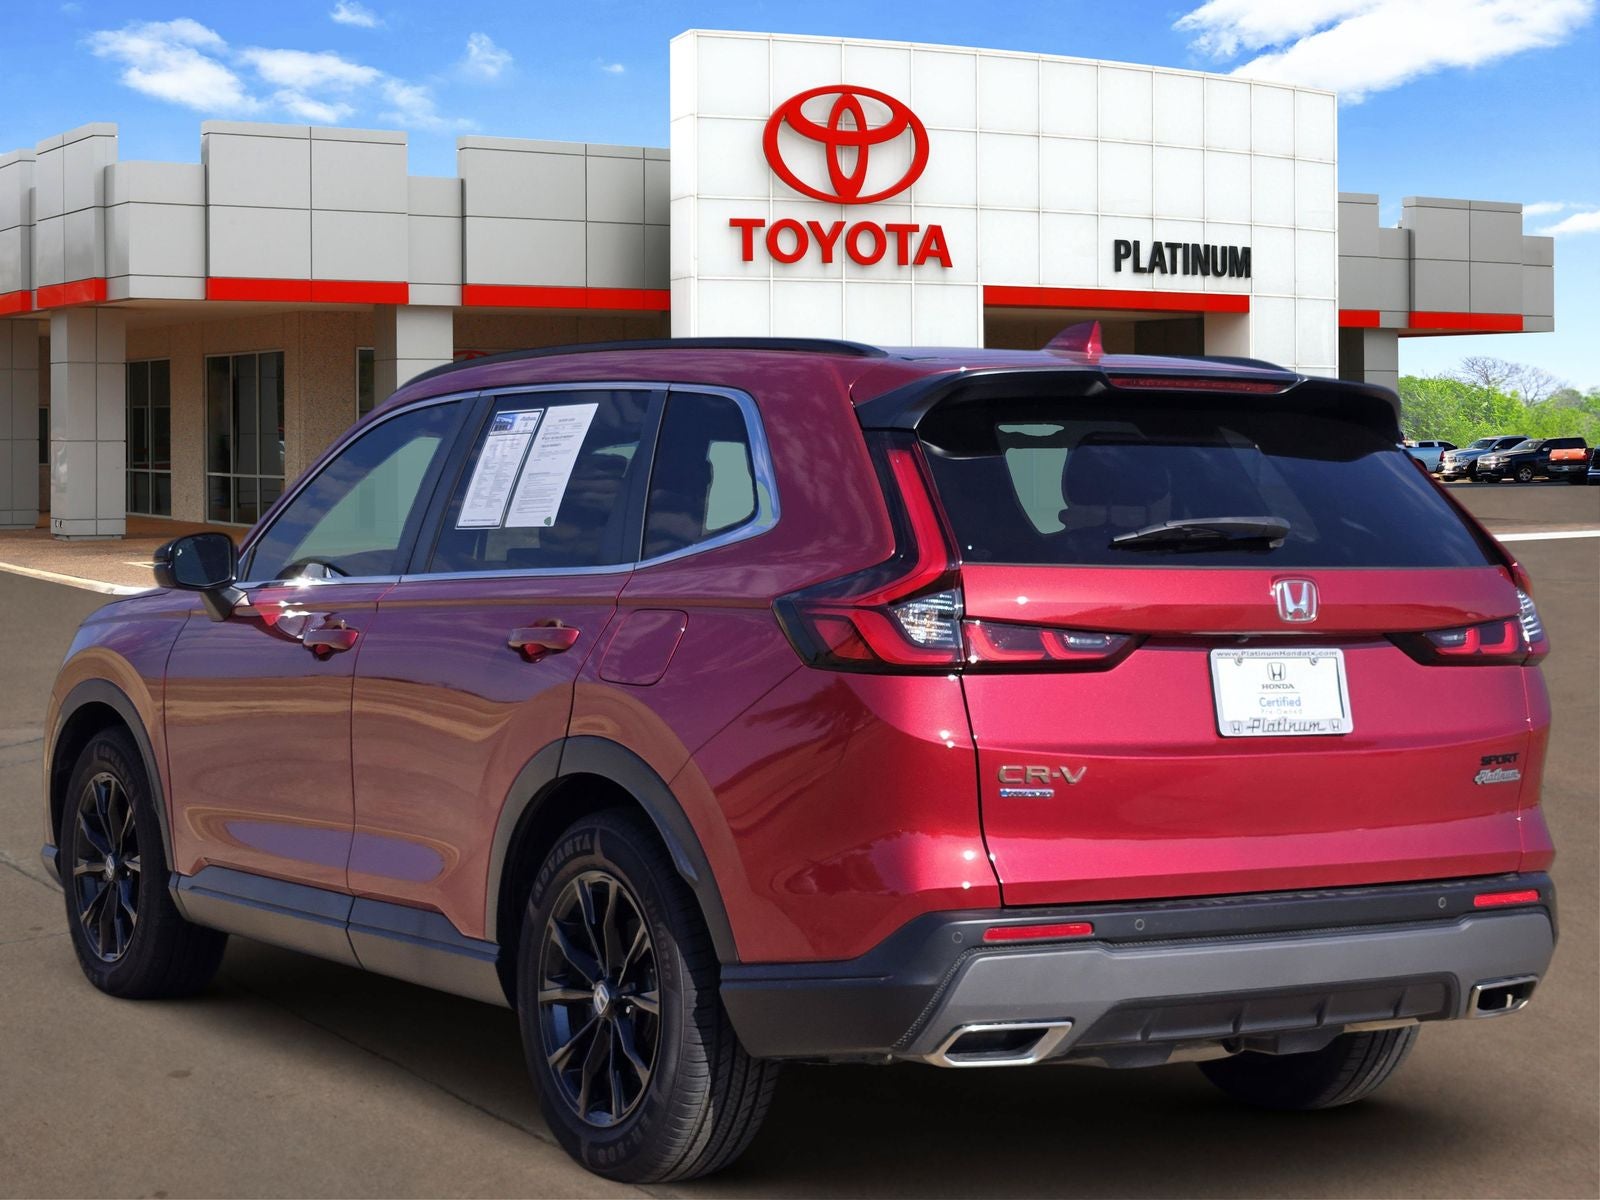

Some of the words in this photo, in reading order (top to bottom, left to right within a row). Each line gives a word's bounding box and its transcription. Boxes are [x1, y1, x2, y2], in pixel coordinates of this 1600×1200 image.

[729, 217, 953, 269] TOYOTA
[1114, 239, 1252, 279] PLATINUM
[1259, 696, 1301, 707] Certified
[1246, 717, 1326, 733] Platinum
[1480, 752, 1519, 766] SPORT
[998, 765, 1088, 785] CR-V
[532, 832, 591, 897] ADVANTA
